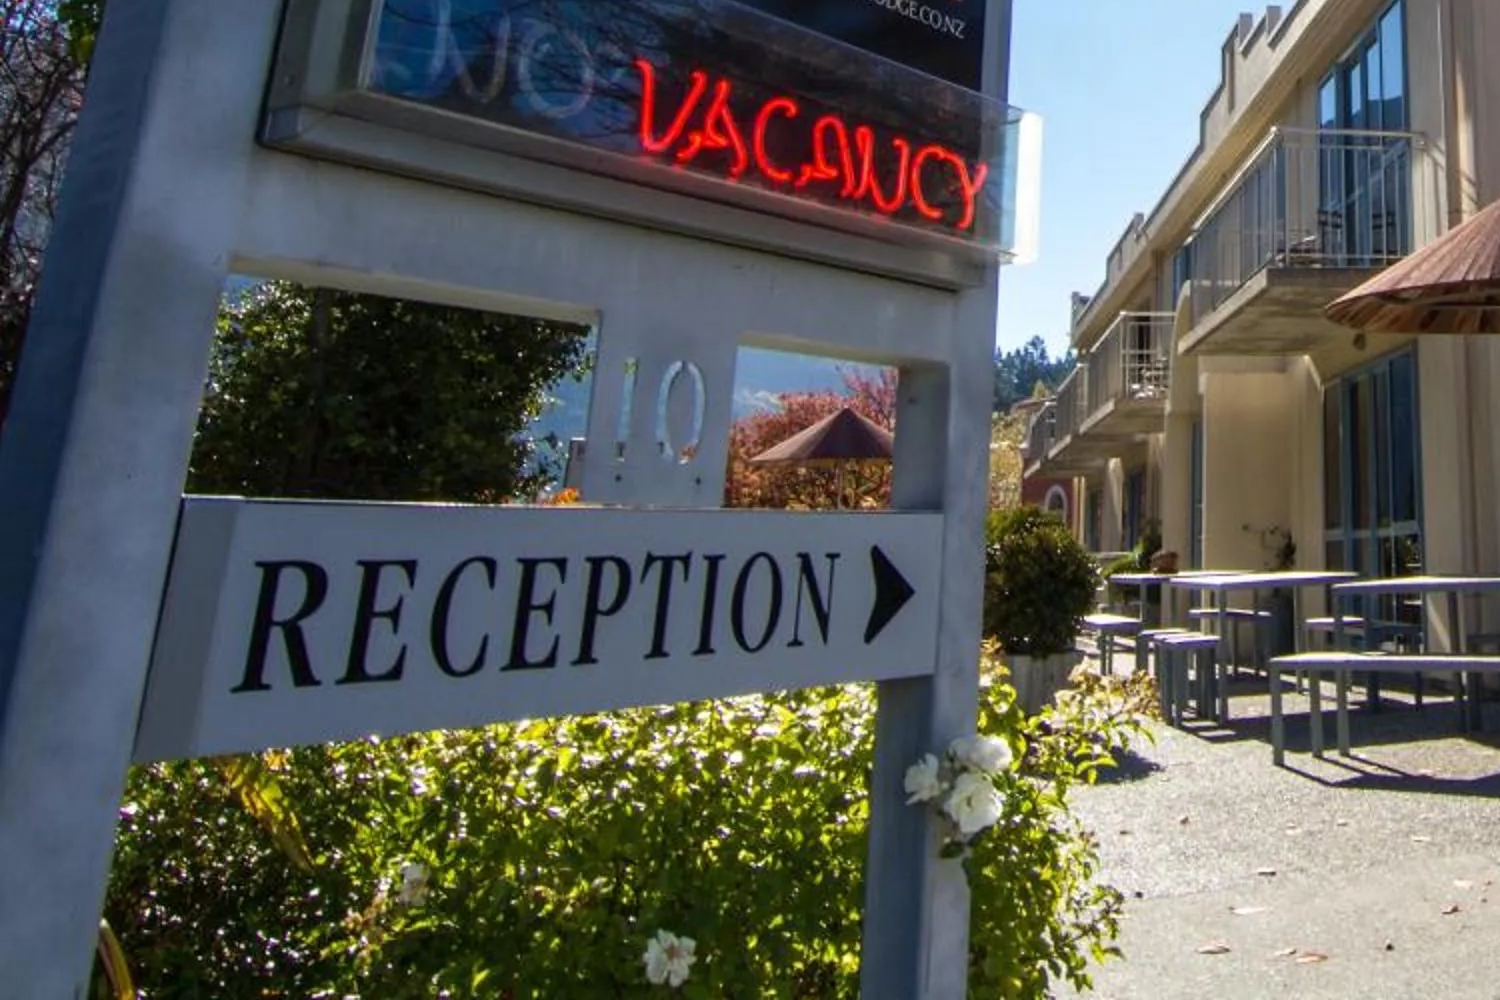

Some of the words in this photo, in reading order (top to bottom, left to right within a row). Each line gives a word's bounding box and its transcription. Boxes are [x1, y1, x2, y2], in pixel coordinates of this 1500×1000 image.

[633, 56, 989, 229] VACANCY
[615, 358, 706, 464] 10
[231, 550, 841, 693] RECEPTION
